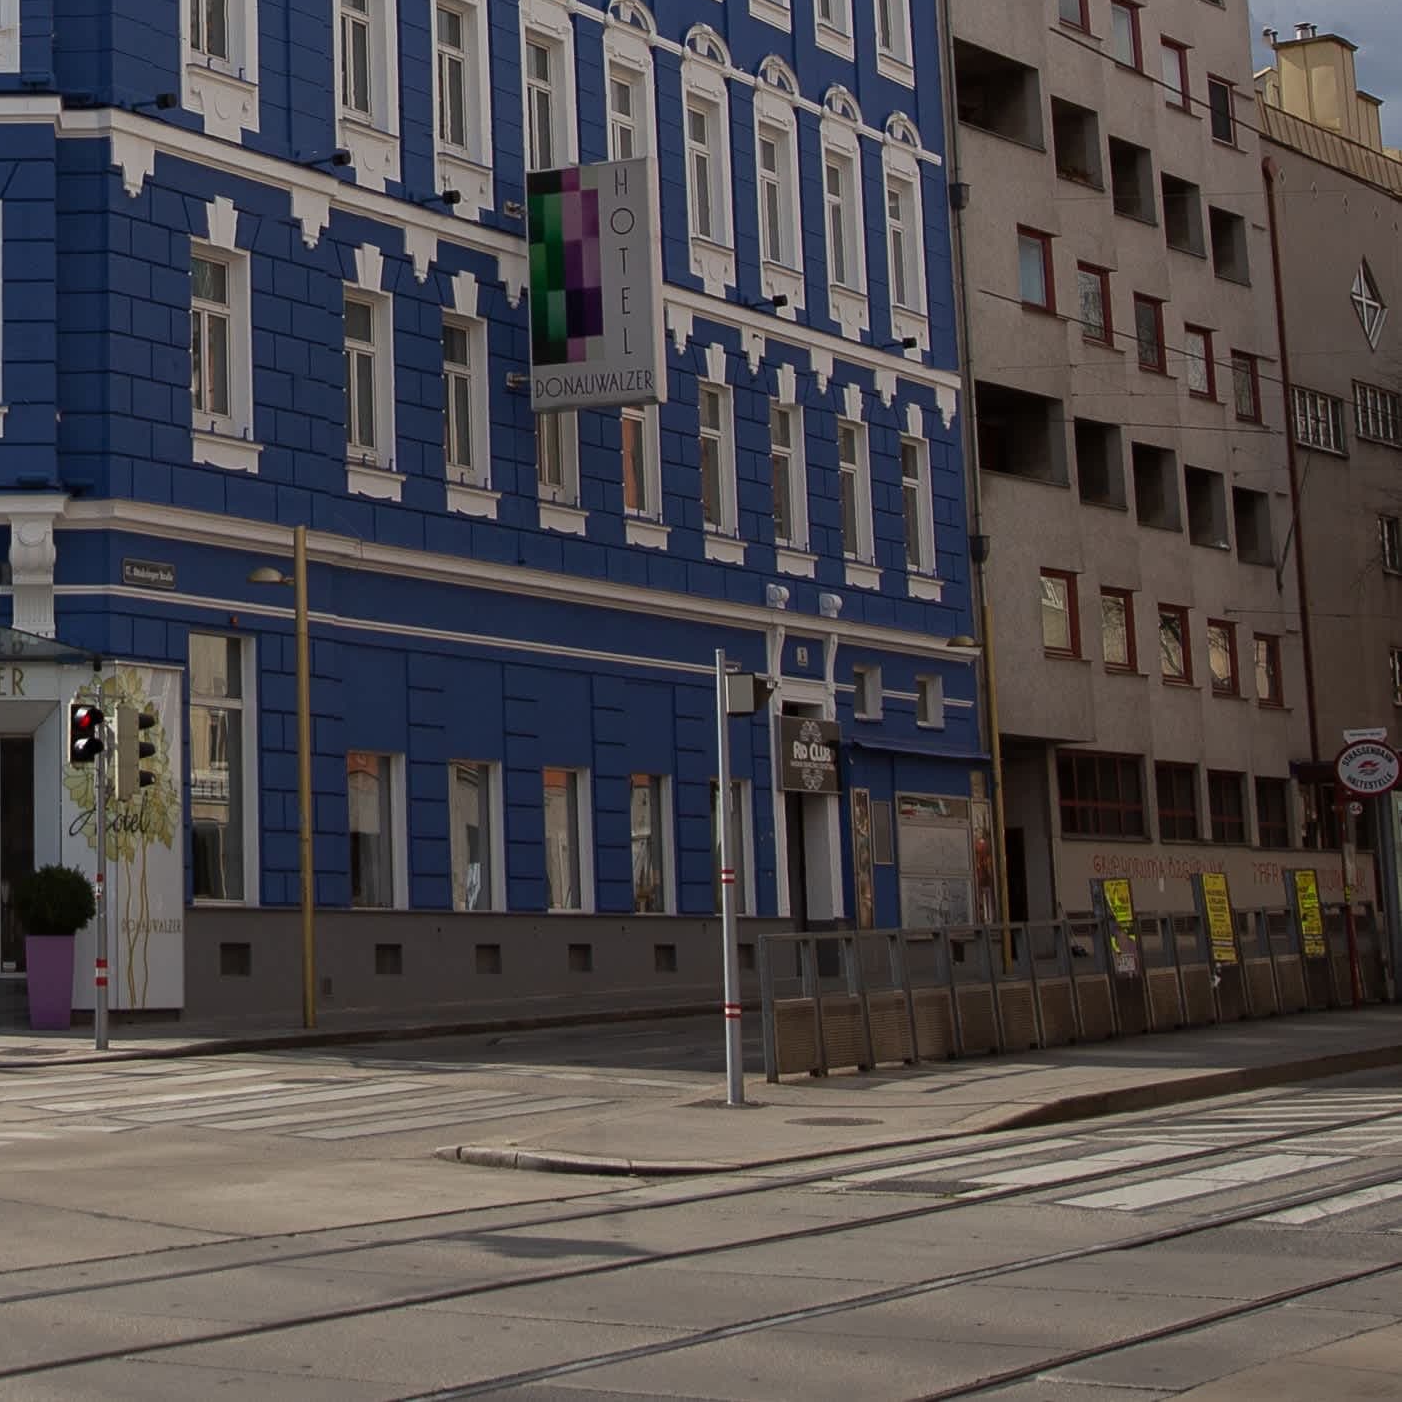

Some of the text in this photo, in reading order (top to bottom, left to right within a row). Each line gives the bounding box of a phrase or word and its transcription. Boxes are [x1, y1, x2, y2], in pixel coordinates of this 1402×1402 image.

[610, 166, 635, 355] HOTEL
[535, 370, 654, 399] DONAUWALZER
[809, 743, 832, 761] CLUB
[1342, 745, 1395, 767] STRASSENBAHN
[1347, 772, 1394, 790] HALTESTELLE
